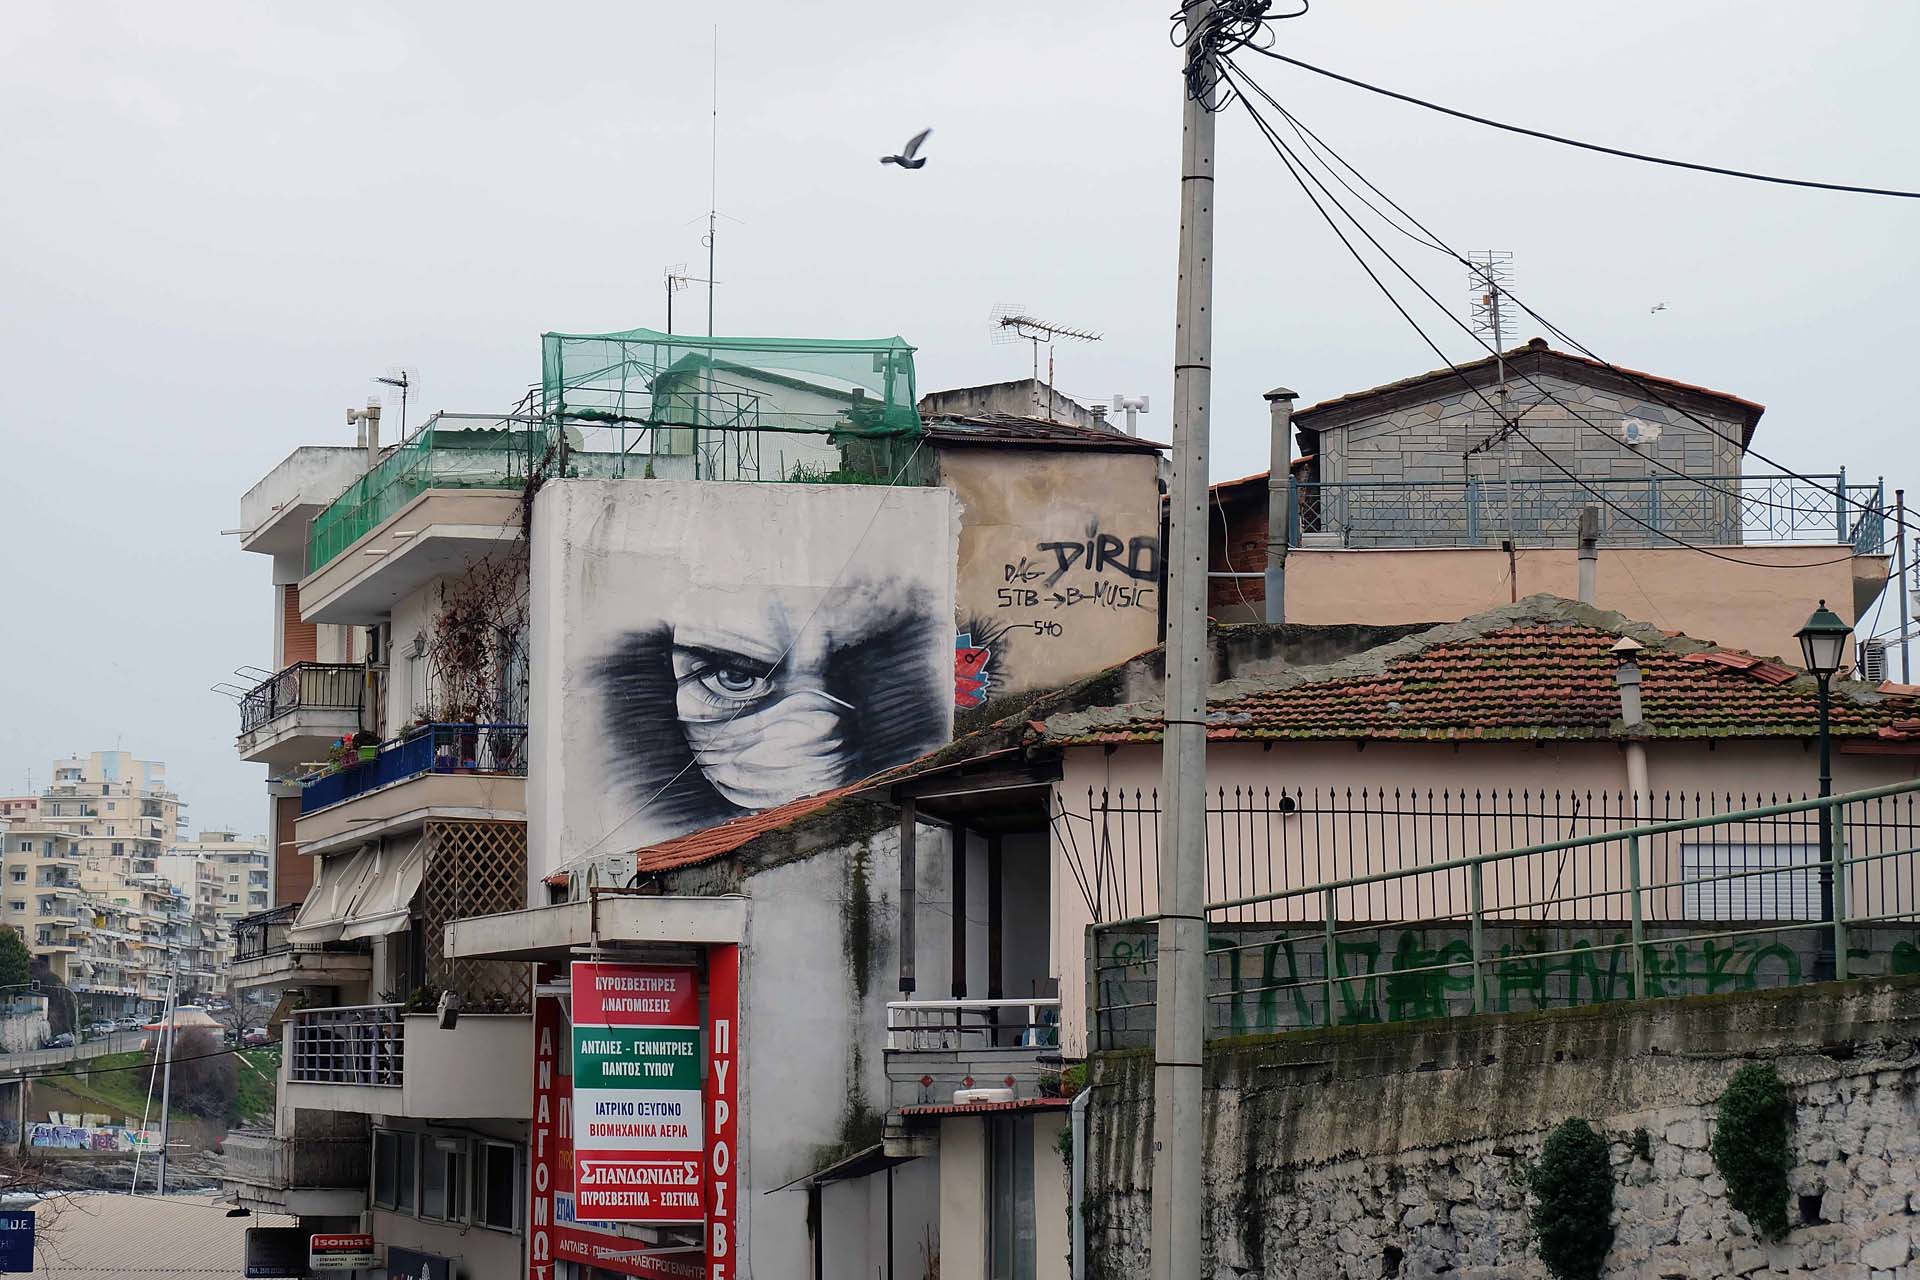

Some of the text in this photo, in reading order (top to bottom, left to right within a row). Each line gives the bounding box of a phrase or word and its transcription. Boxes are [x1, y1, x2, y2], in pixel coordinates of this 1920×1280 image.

[595, 976, 676, 992] ΠΥΡΟΣΒΕΣΤΗΡΕΣ
[601, 998, 671, 1013] ΑΝΑΓΟΜΩΣΕΙΣ
[581, 1040, 622, 1055] ΑΝΤΛΙΕΣ
[634, 1041, 694, 1056] ΓΕΝΝΗΤΡΙΕΣ
[602, 1062, 674, 1077] ΠΑΝΤΟΣ ΤΥΠΟΥ
[595, 1102, 682, 1116] ΙΑΤΡΙΚΟ ΟΞΥΓΟΝΟ
[589, 1123, 688, 1138] ΒΙΟΜΗΧΑΝΙΚΑ ΑΕΡΙΑ
[580, 1160, 699, 1185] ΣΠΑΝΔΩΝΙΔΗΣ
[581, 1191, 650, 1206] ΠΥΡΟΣΒΕΣΤΙΚΑ
[660, 1192, 699, 1206] ΣΩΣΤΙΚΑ
[560, 1239, 589, 1256] ΑΝΤΛΙΕΣ
